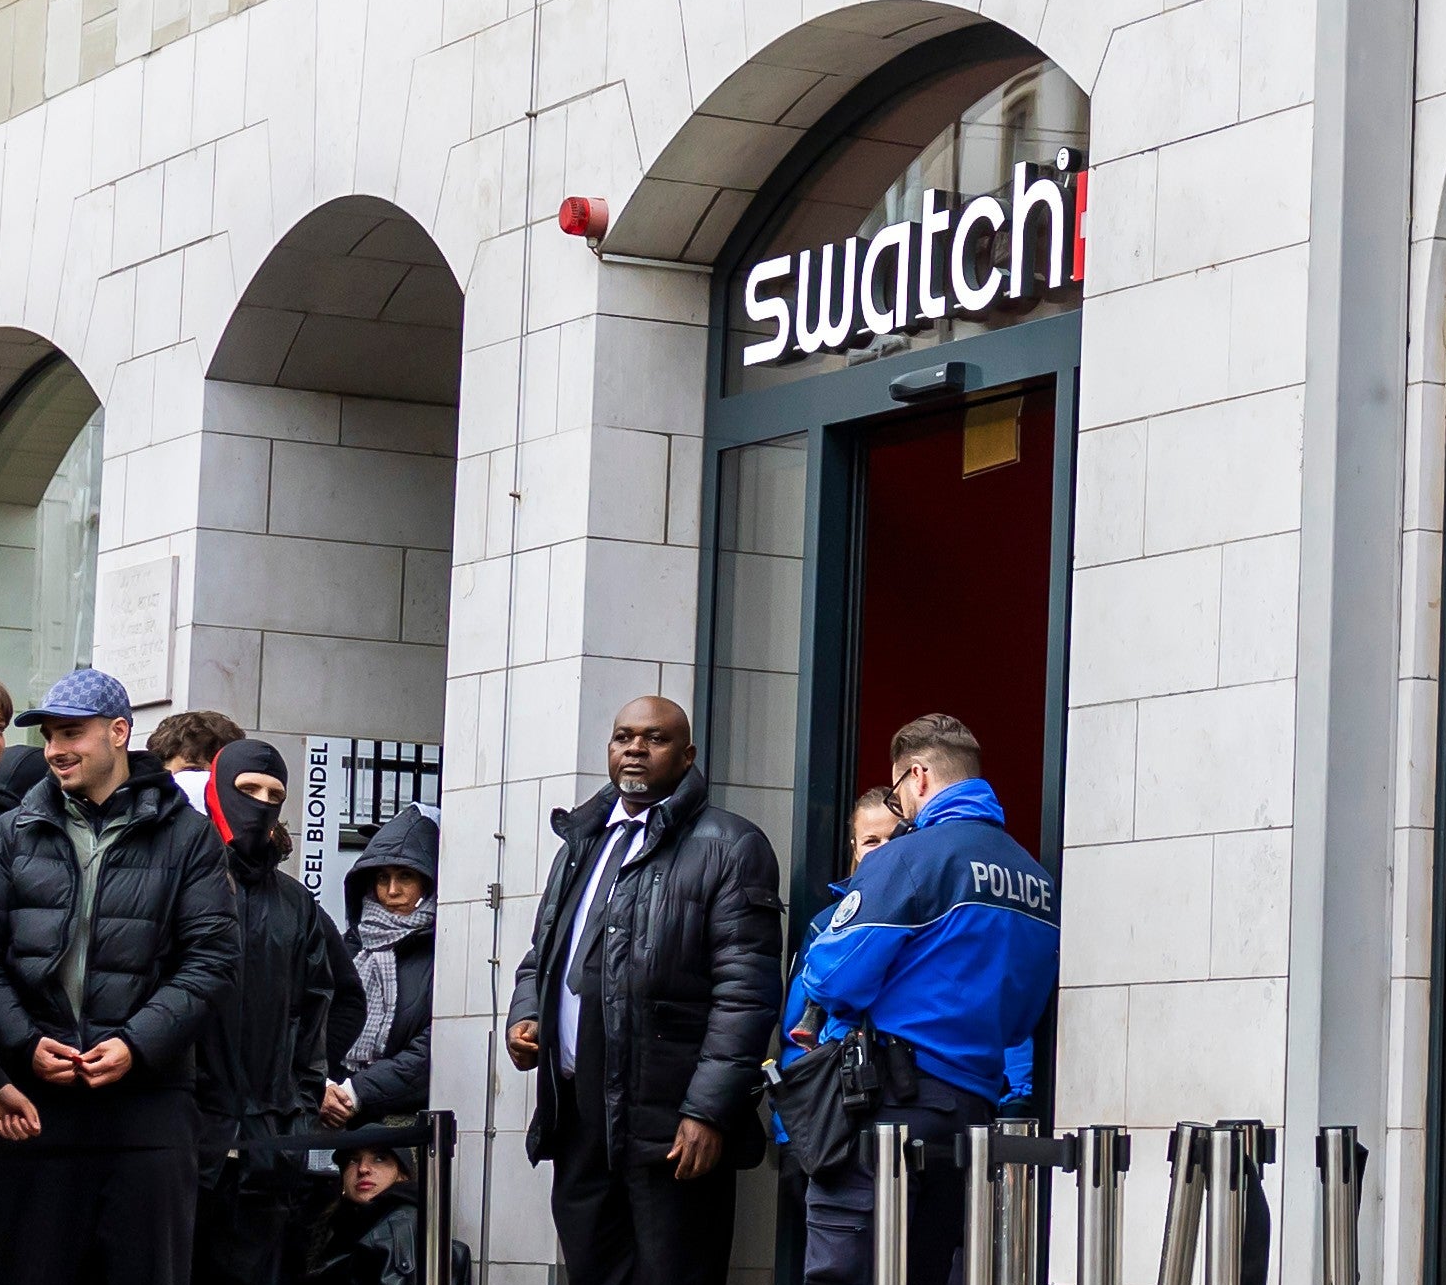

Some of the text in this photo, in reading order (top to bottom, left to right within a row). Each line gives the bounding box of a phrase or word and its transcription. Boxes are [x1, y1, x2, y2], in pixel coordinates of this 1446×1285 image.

[743, 161, 1064, 366] swatch
[307, 742, 328, 842] BLONDEL
[970, 861, 1052, 912] POLICE
